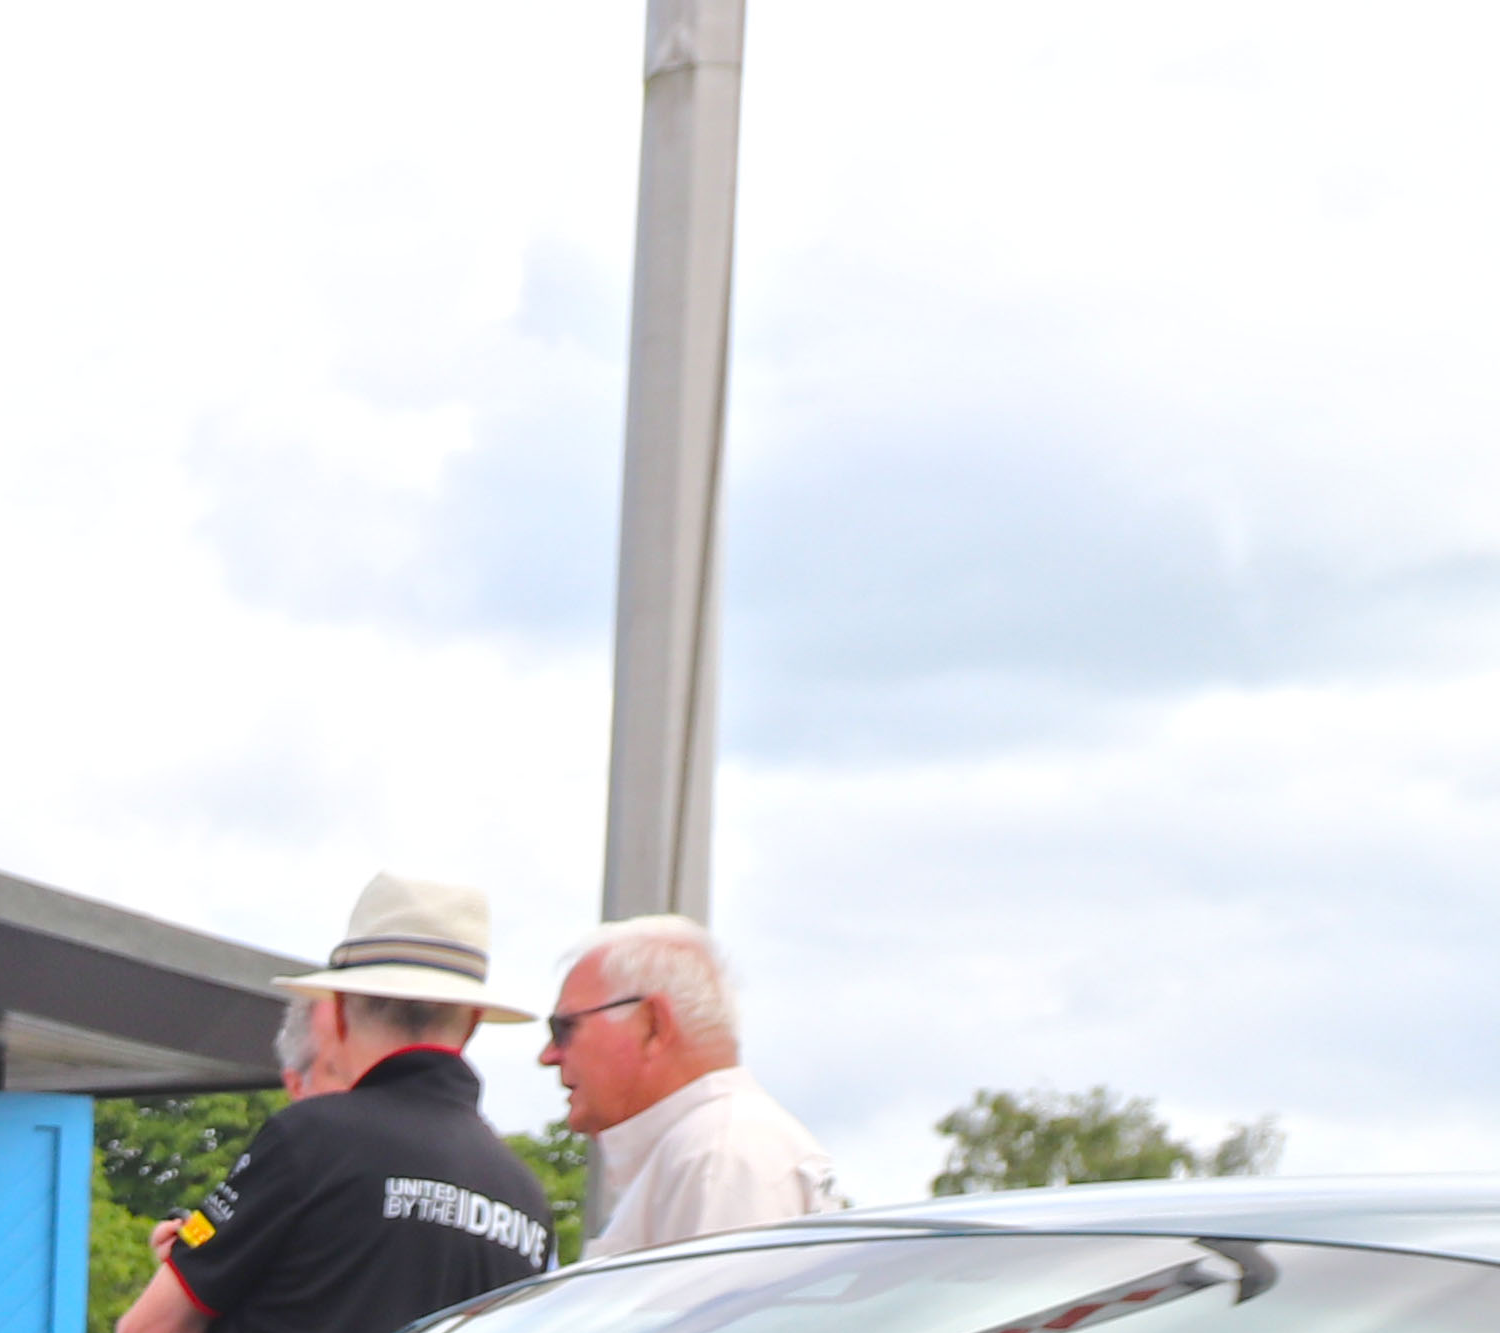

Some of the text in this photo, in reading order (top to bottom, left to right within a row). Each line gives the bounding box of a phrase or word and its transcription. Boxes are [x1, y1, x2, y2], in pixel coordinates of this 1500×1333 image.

[385, 1176, 457, 1203] UNITED
[382, 1195, 456, 1226] BY THE
